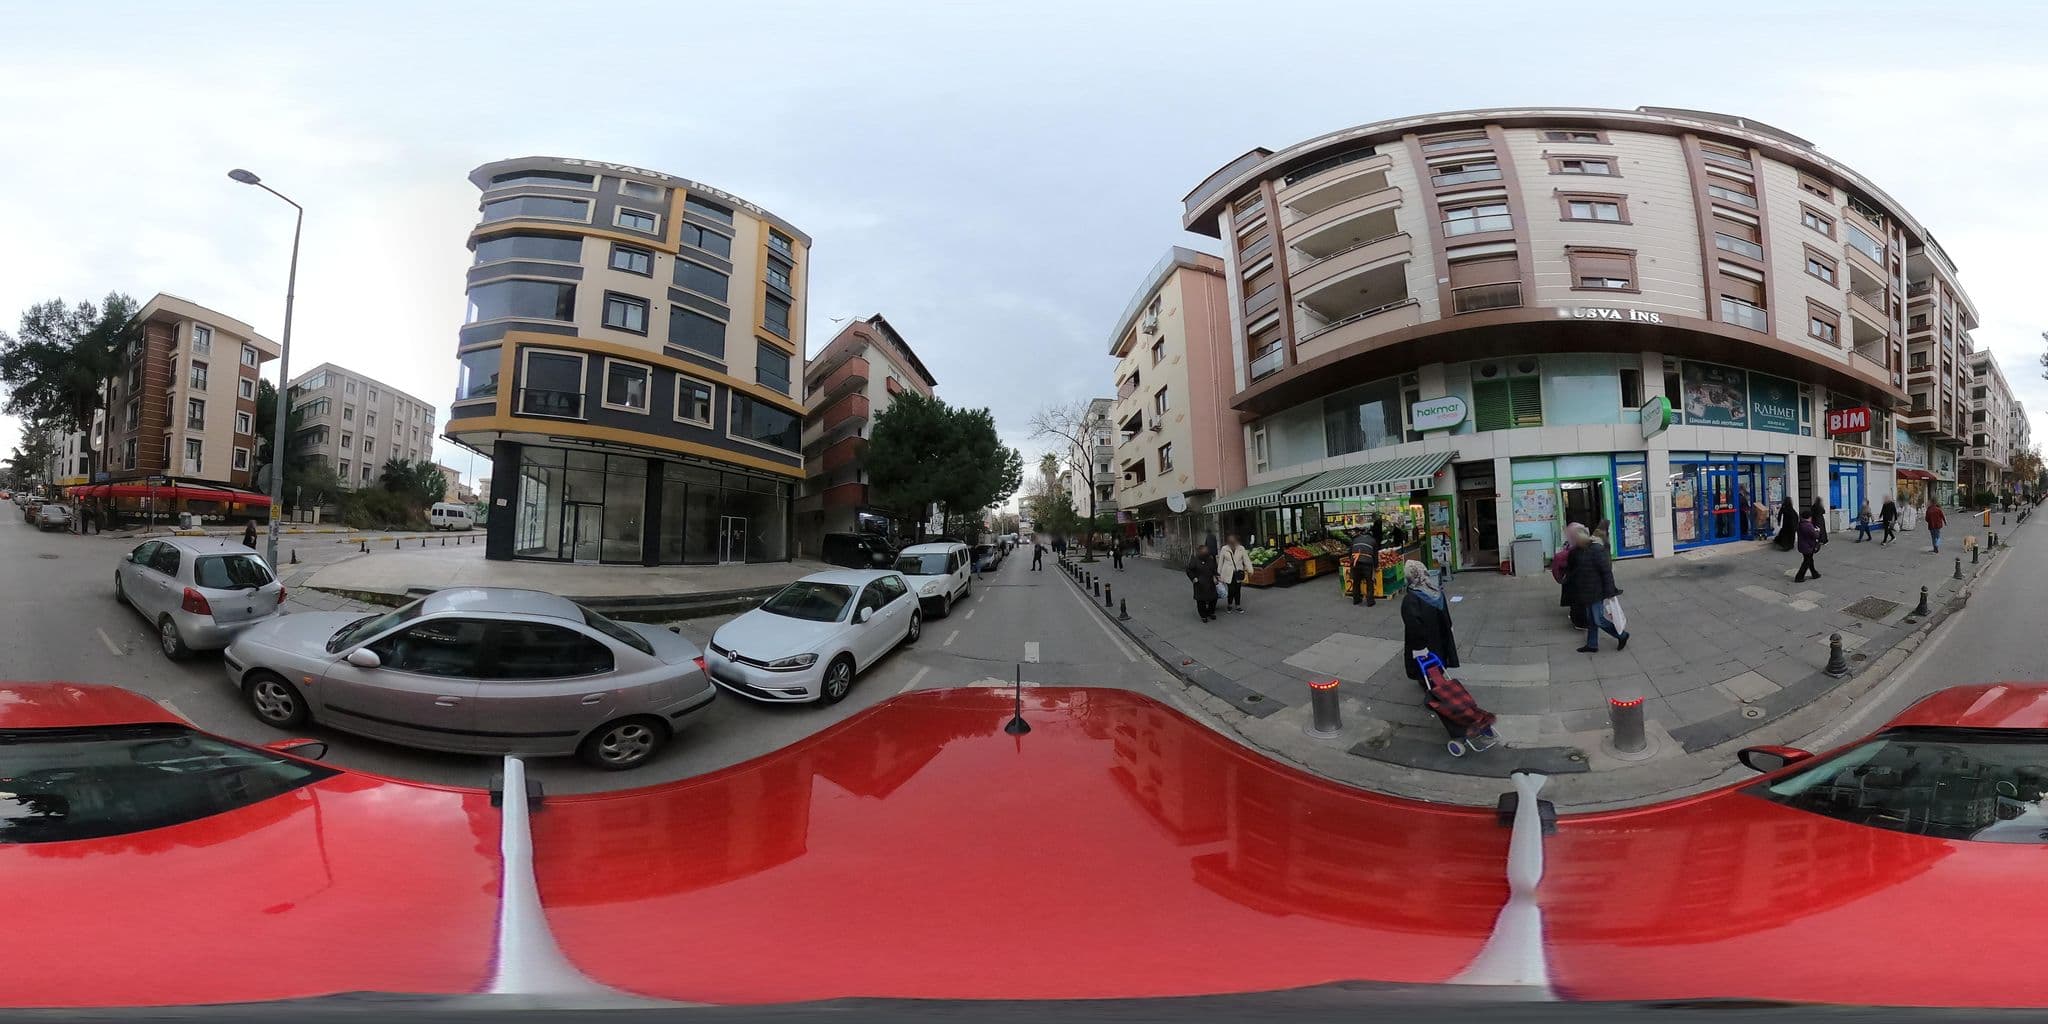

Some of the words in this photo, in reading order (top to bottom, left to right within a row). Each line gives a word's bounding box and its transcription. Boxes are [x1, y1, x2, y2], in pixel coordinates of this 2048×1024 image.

[1416, 404, 1459, 417] hakmar
[1753, 402, 1796, 418] RAHMET
[1830, 409, 1865, 431] BİM
